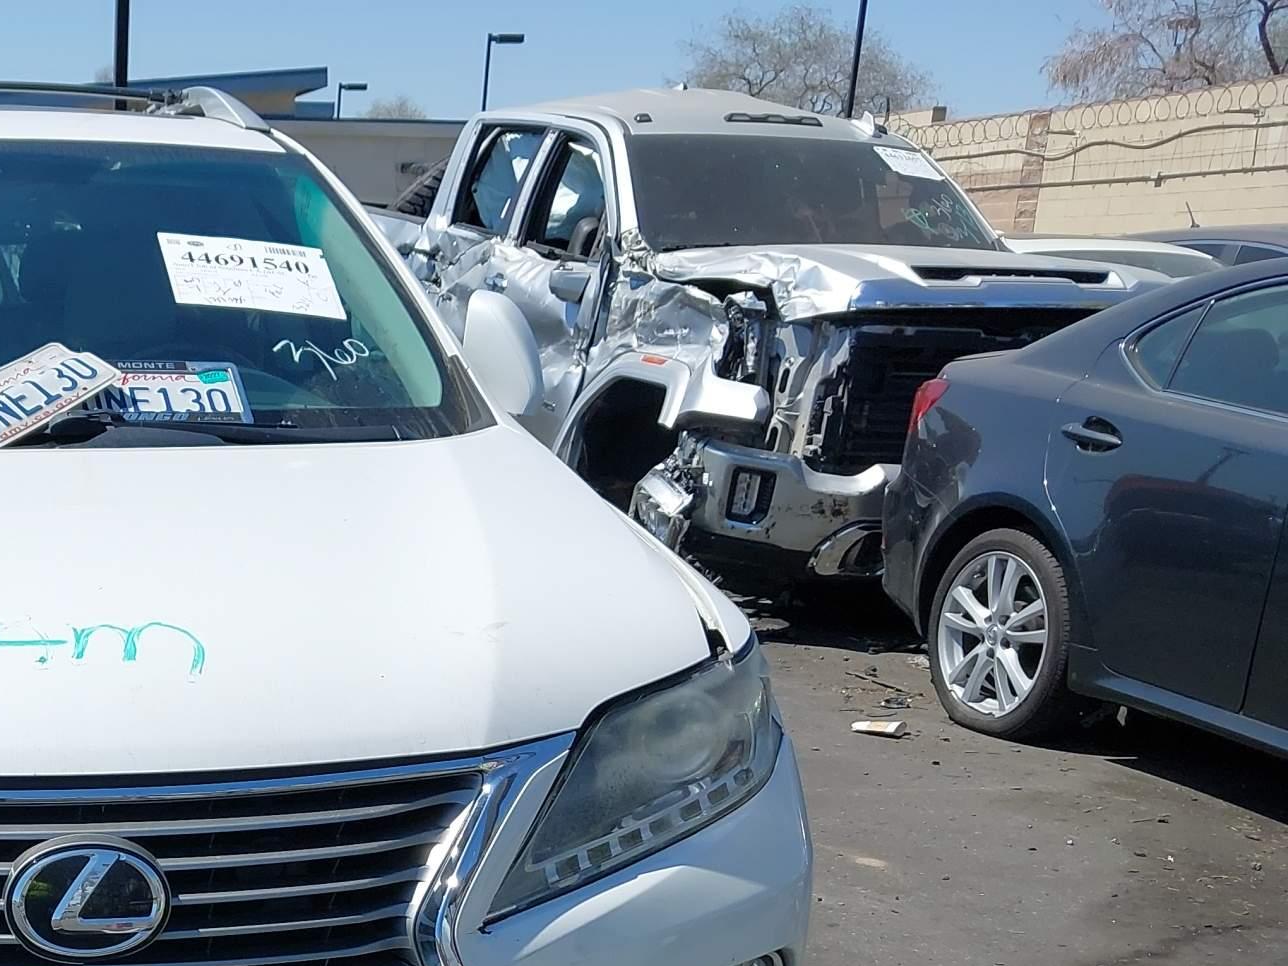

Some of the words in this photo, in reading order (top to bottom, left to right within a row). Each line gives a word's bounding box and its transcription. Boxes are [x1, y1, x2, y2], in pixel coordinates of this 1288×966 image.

[181, 251, 310, 274] 44691540
[121, 372, 186, 386] fornia
[83, 386, 232, 412] NE130
[123, 412, 190, 421] ONGO
